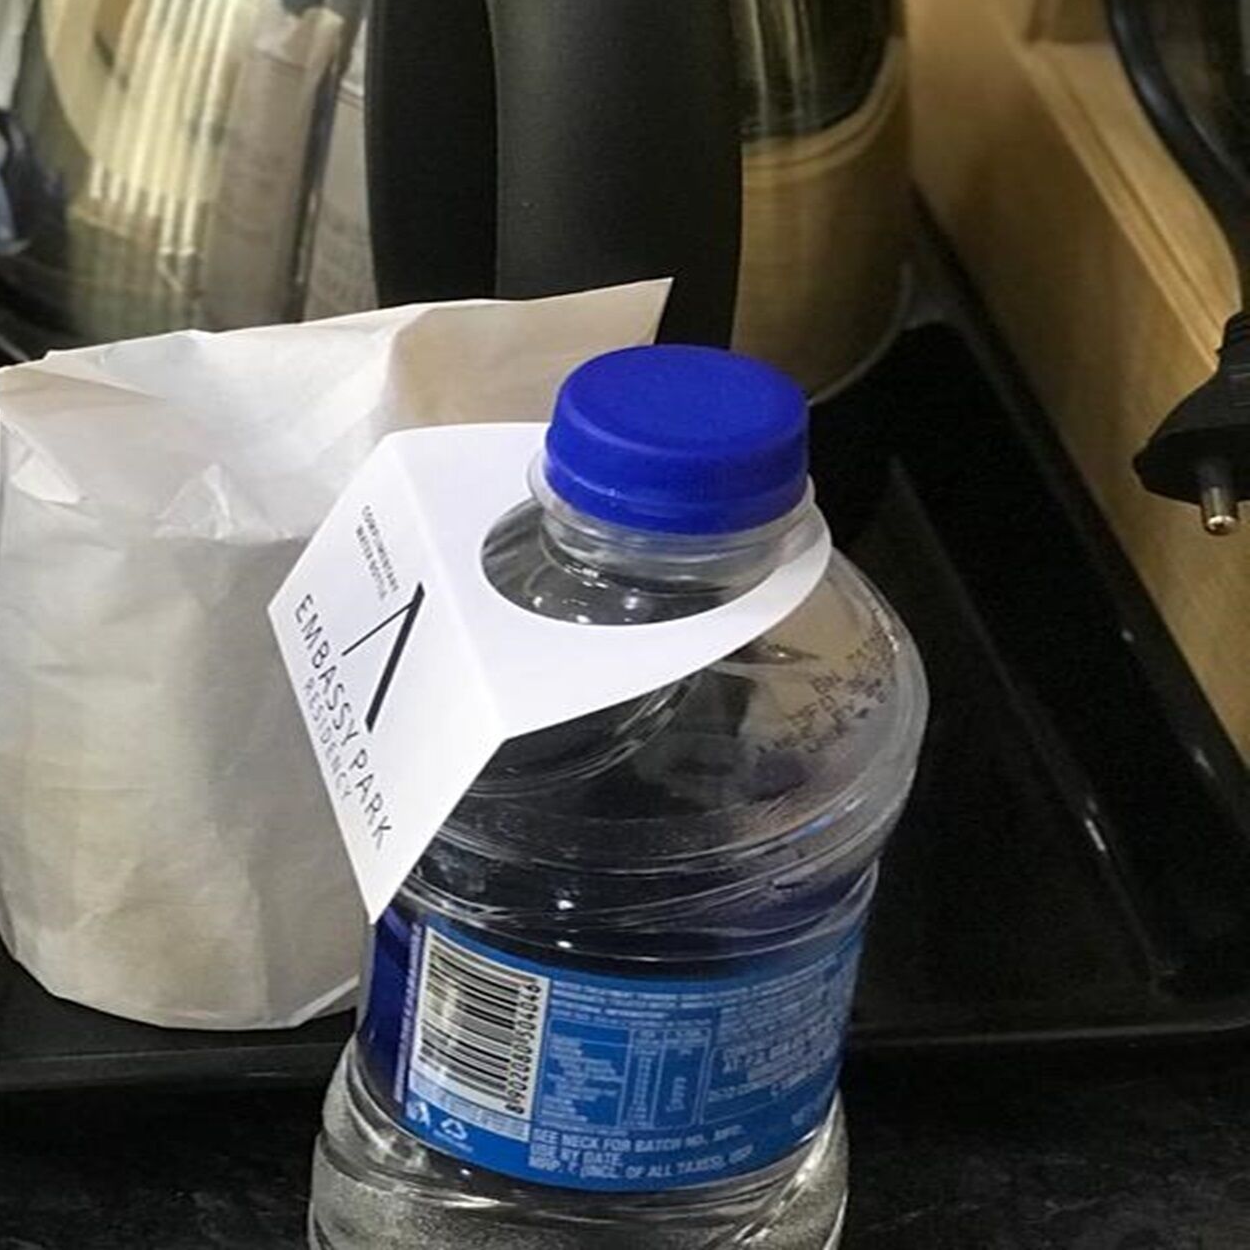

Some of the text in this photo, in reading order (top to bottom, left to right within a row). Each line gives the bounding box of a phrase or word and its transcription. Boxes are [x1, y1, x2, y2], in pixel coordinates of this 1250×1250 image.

[295, 593, 393, 851] EMBASSY PARK
[304, 676, 352, 800] RESIDENCY
[561, 1133, 601, 1151] NECK
[602, 1136, 632, 1152] FOR
[633, 1138, 683, 1153] BATCH
[625, 1164, 647, 1180] OF
[647, 1161, 673, 1178] ALL
